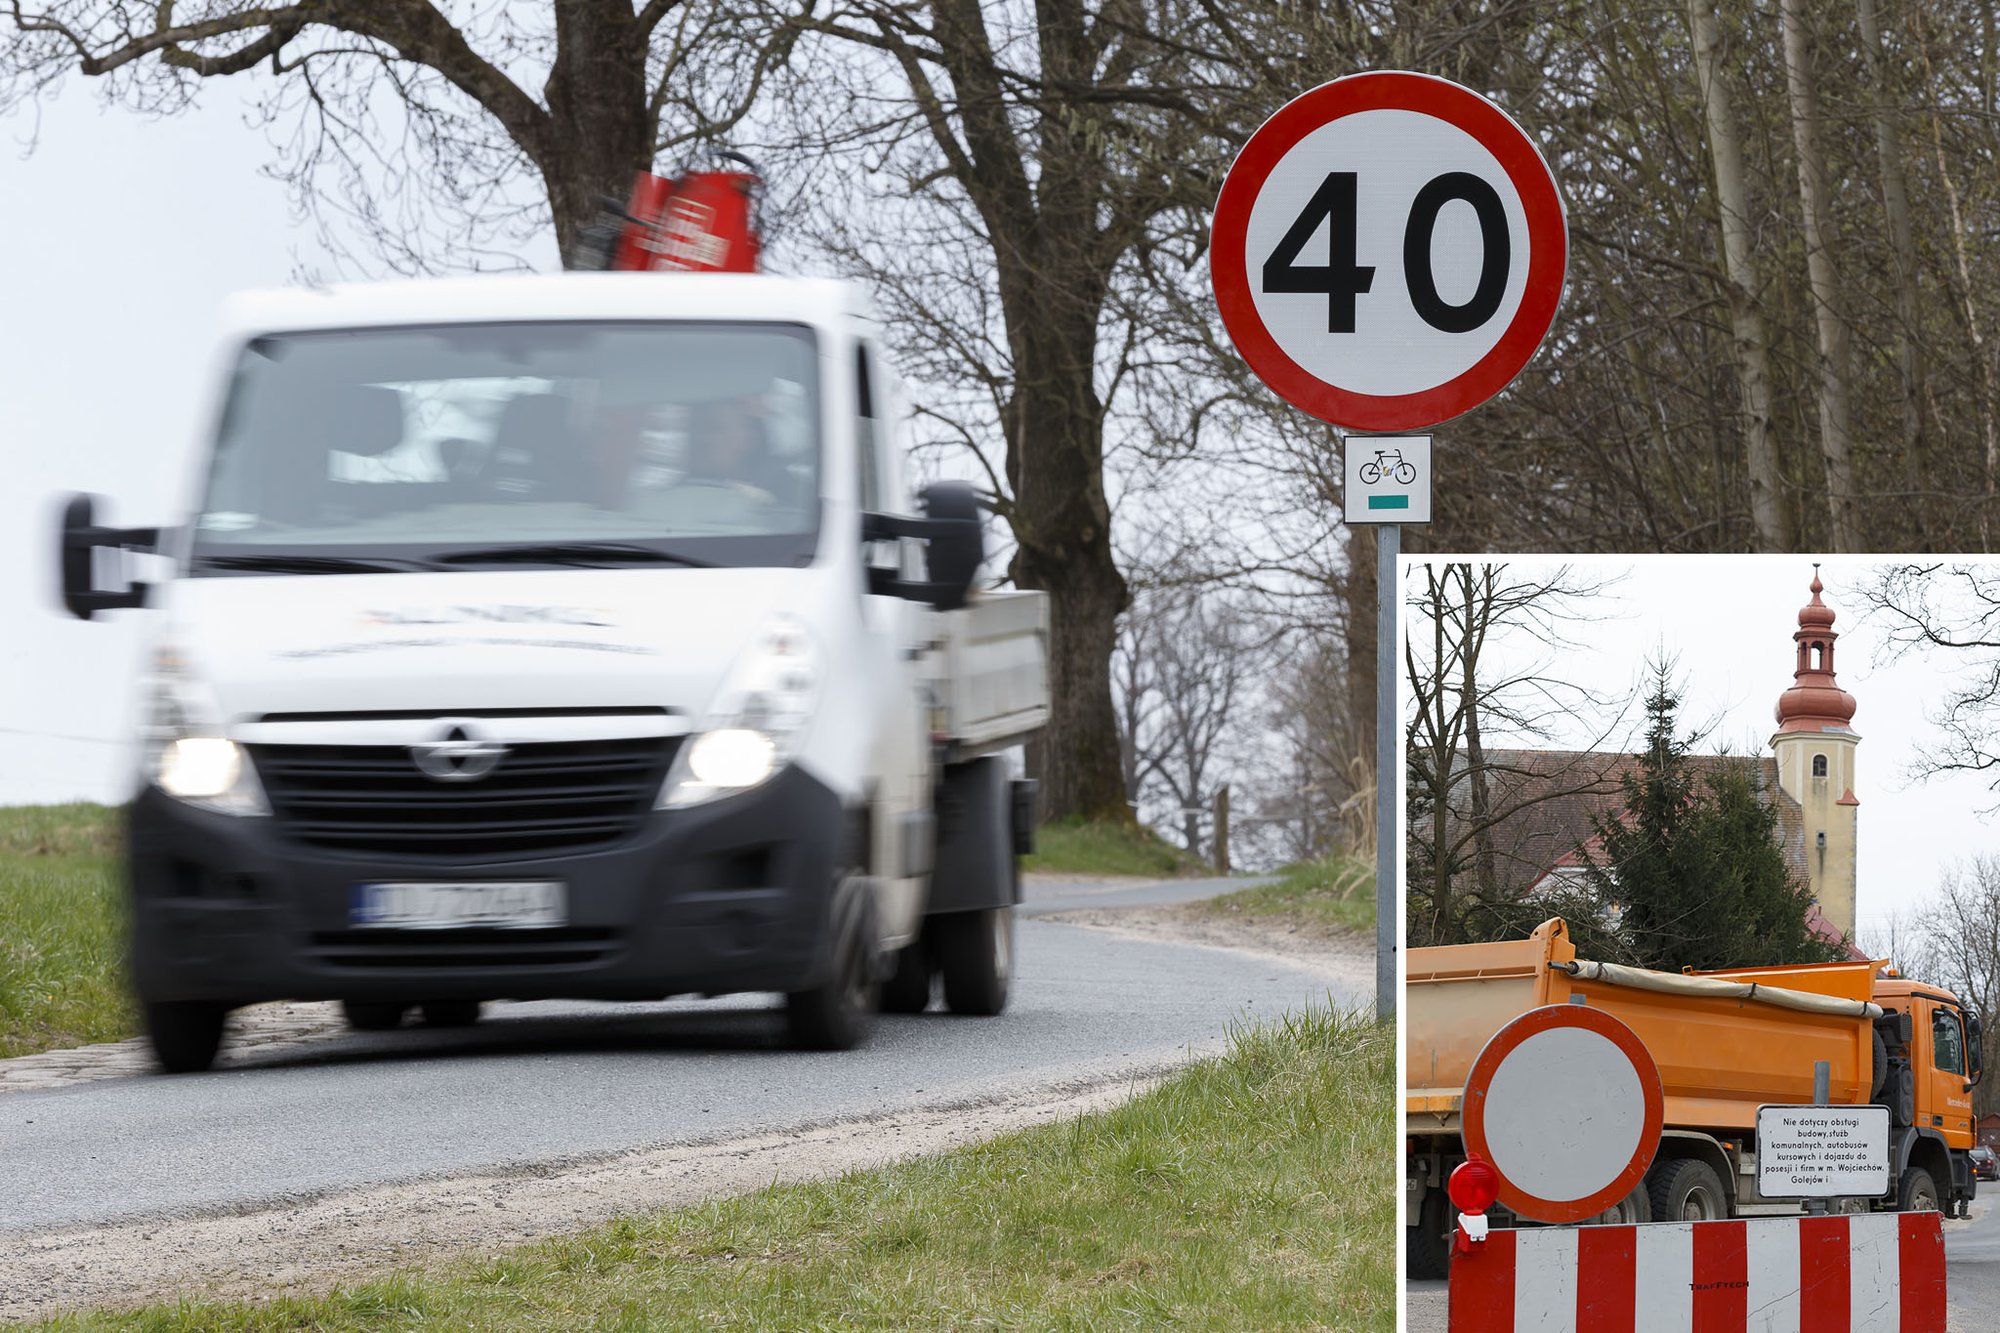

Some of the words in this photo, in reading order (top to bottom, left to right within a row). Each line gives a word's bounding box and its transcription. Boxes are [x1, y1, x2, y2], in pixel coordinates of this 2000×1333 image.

[1262, 171, 1511, 333] 40
[1783, 1118, 1797, 1126] Nie
[1799, 1118, 1828, 1128] dotyczy
[1831, 1118, 1860, 1128] obsługi
[1827, 1140, 1868, 1149] autobusów
[1777, 1152, 1816, 1162] kursowych
[1824, 1152, 1855, 1162] dojazdu
[1856, 1152, 1867, 1160] do
[1765, 1164, 1793, 1174] posesji
[1800, 1164, 1815, 1172] firm
[1790, 1175, 1823, 1185] Golejów
